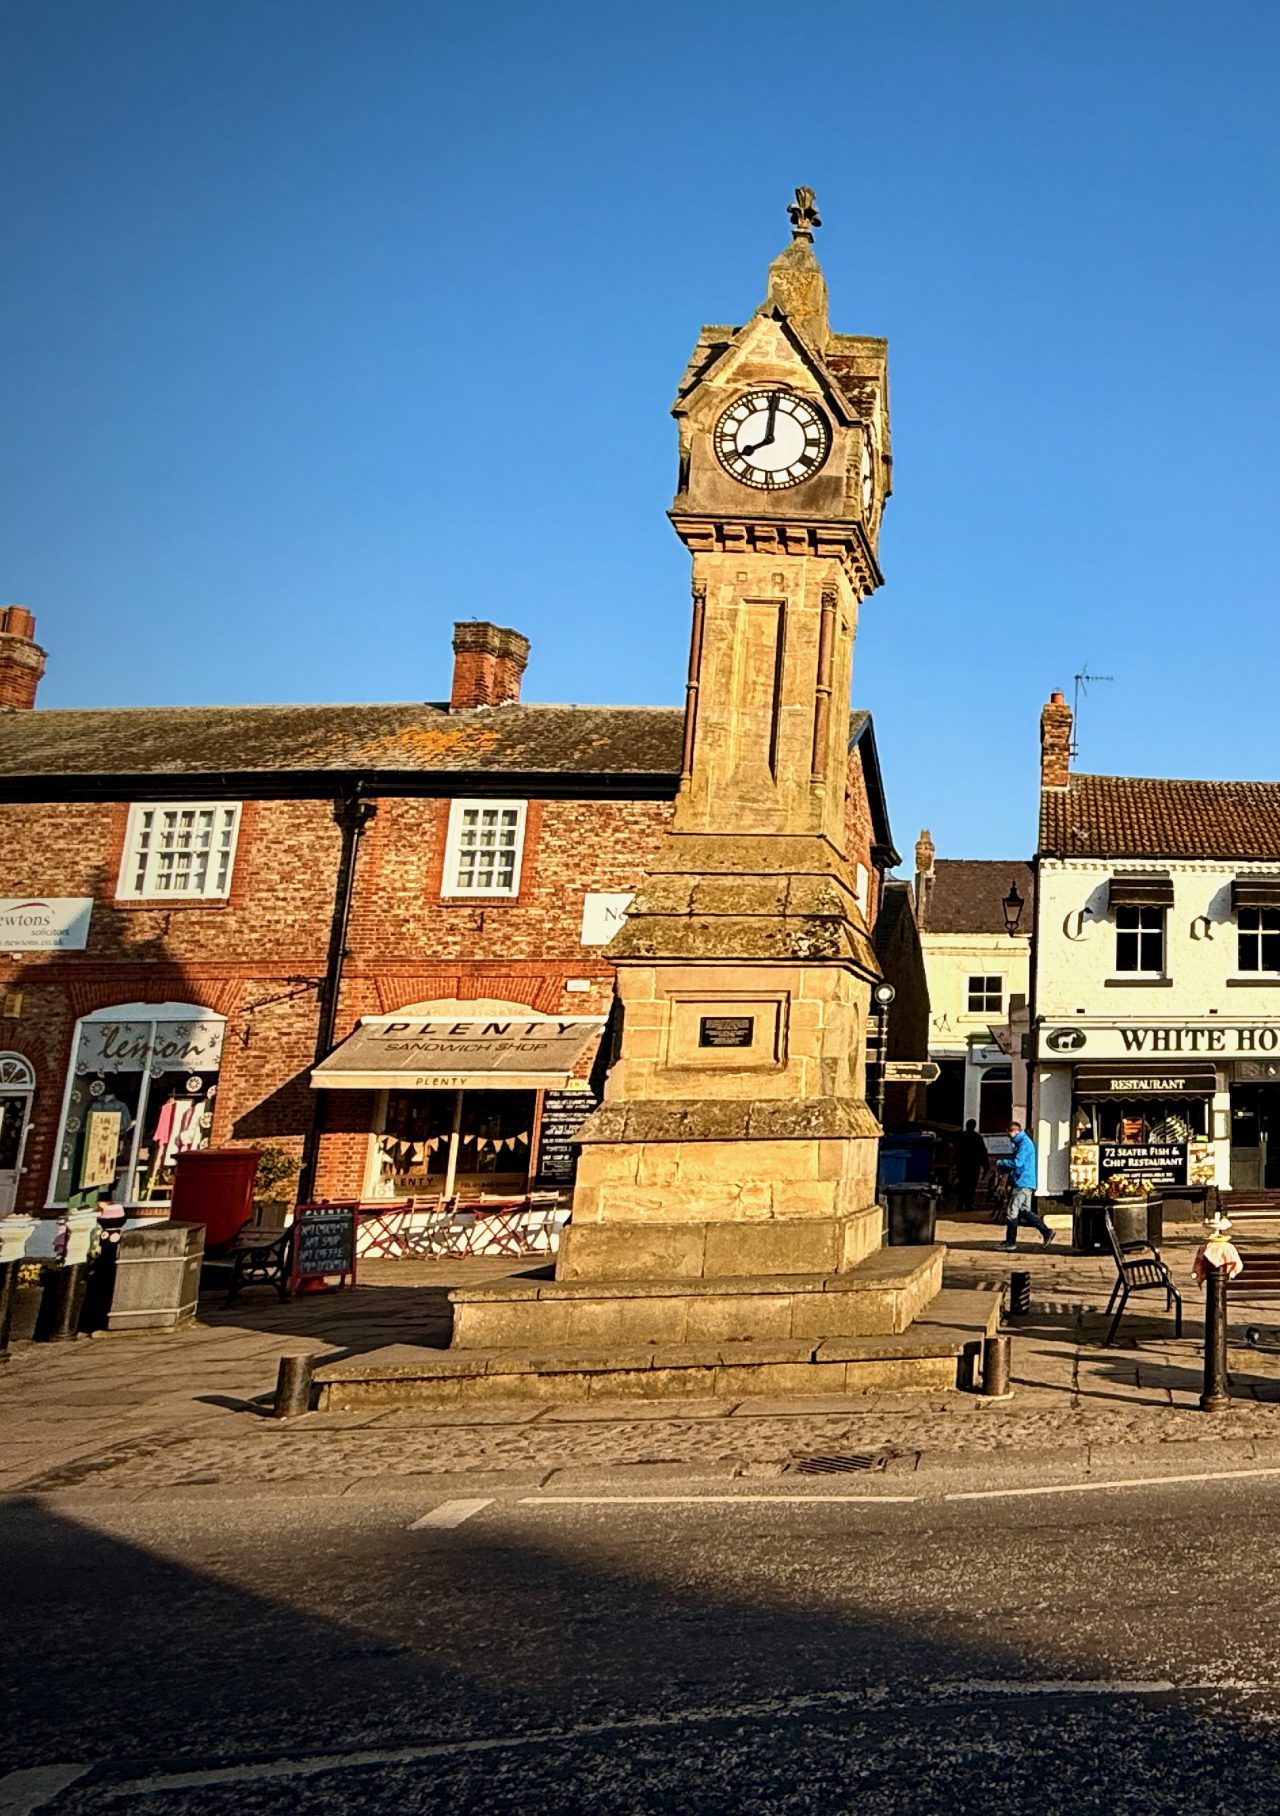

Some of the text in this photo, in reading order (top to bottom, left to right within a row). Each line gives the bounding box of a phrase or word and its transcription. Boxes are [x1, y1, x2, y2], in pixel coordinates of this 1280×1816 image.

[383, 1022, 579, 1035] PLENTY
[98, 1026, 206, 1060] lemon
[1119, 1029, 1226, 1051] WHITE
[384, 1042, 548, 1052] SANDWICH SHOP
[415, 1077, 468, 1087] PLENTY
[1110, 1079, 1186, 1090] RESTAURANT
[1171, 1147, 1180, 1155] &
